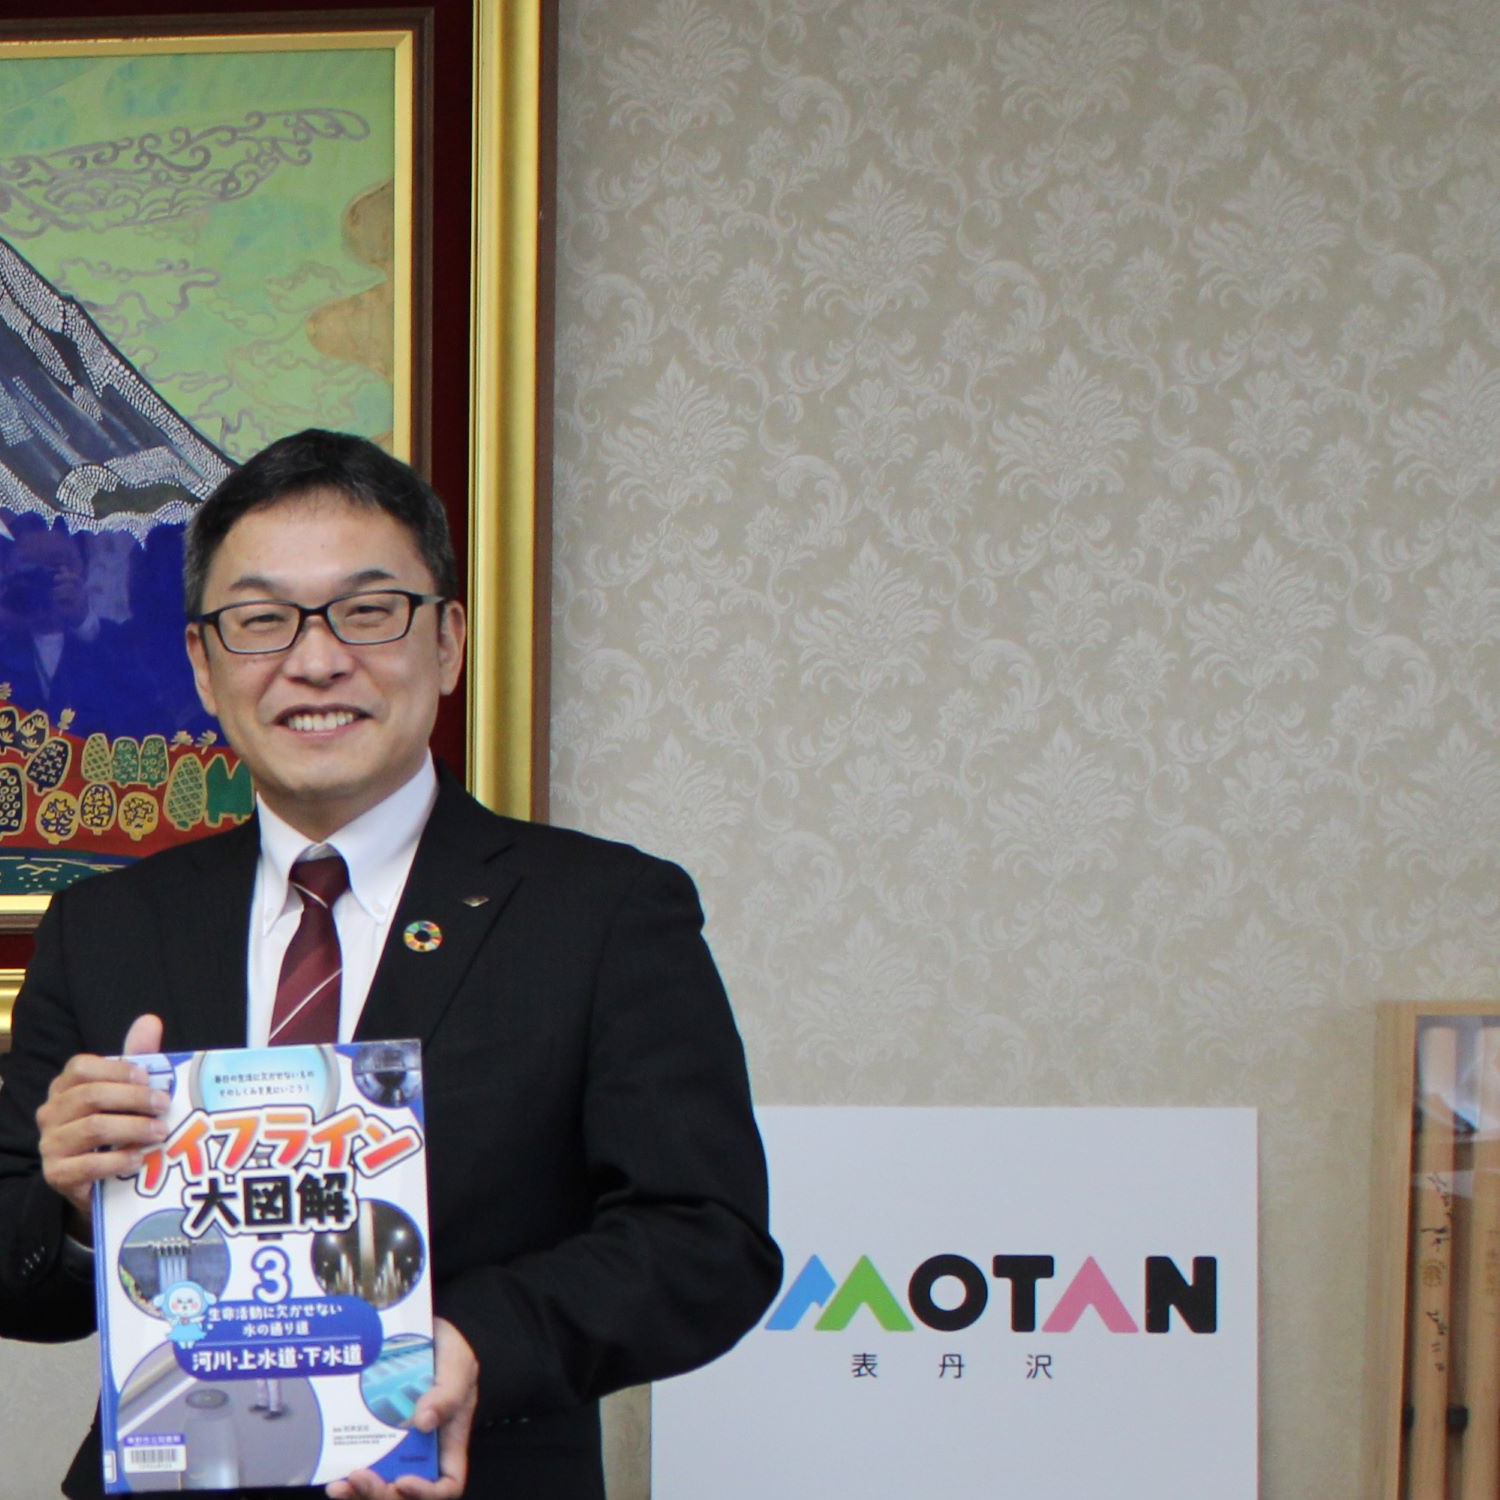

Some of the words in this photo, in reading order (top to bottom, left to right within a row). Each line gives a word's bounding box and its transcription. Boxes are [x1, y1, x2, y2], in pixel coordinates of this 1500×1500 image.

[190, 1173, 352, 1231] 大図解
[254, 1249, 288, 1299] 3
[208, 1304, 343, 1325] 生命活動に欠かせない
[243, 1322, 310, 1337] 水の通り道
[192, 1346, 363, 1372] 河川・上水道・下水道
[852, 1353, 1053, 1379] 表丹沢
